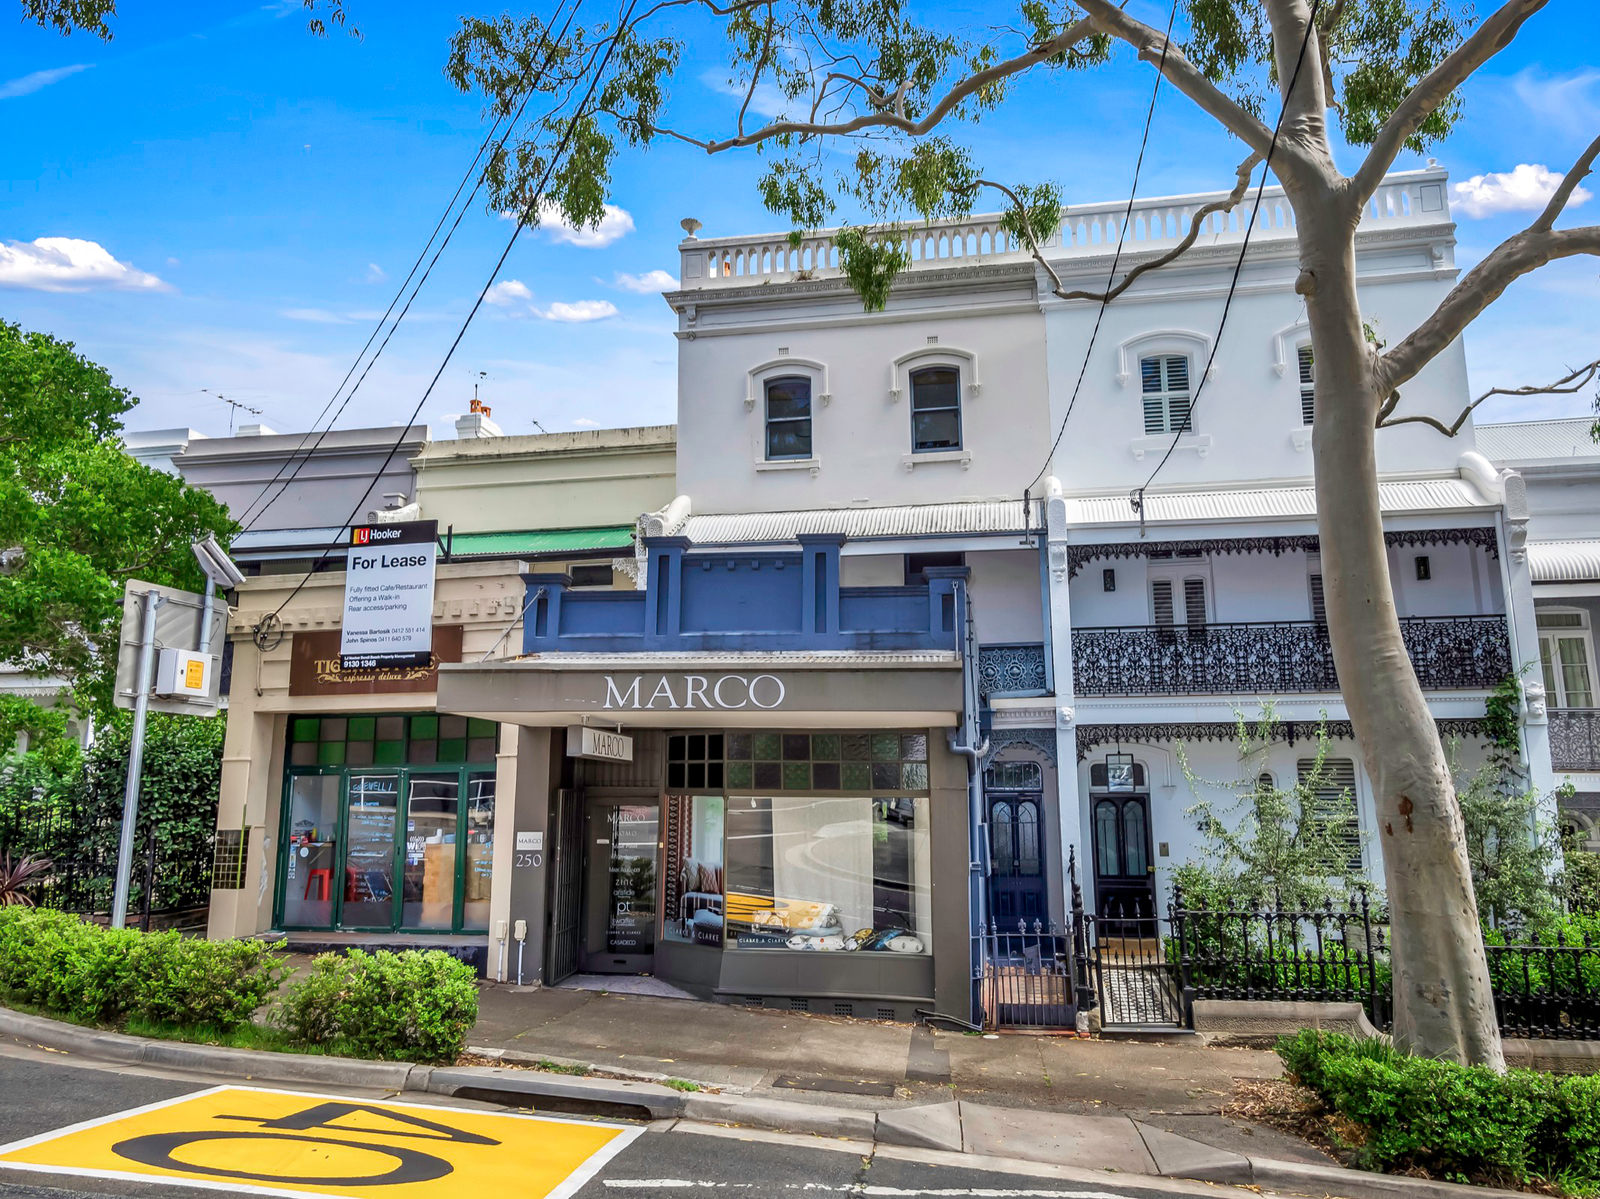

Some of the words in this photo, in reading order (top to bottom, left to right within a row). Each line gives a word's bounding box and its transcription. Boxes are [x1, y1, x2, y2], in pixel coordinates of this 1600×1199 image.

[360, 530, 368, 542] LJ
[370, 528, 401, 540] Hooker
[352, 556, 377, 570] For
[381, 555, 426, 568] Lease
[380, 583, 428, 591] Cafe/Restaurant
[378, 672, 401, 680] deluxe
[602, 674, 785, 709] MARCO
[593, 732, 624, 757] MARCO
[607, 814, 646, 822] MARCO
[516, 854, 542, 867] 250
[698, 931, 719, 942] CLARKE
[111, 1102, 502, 1186] 40
